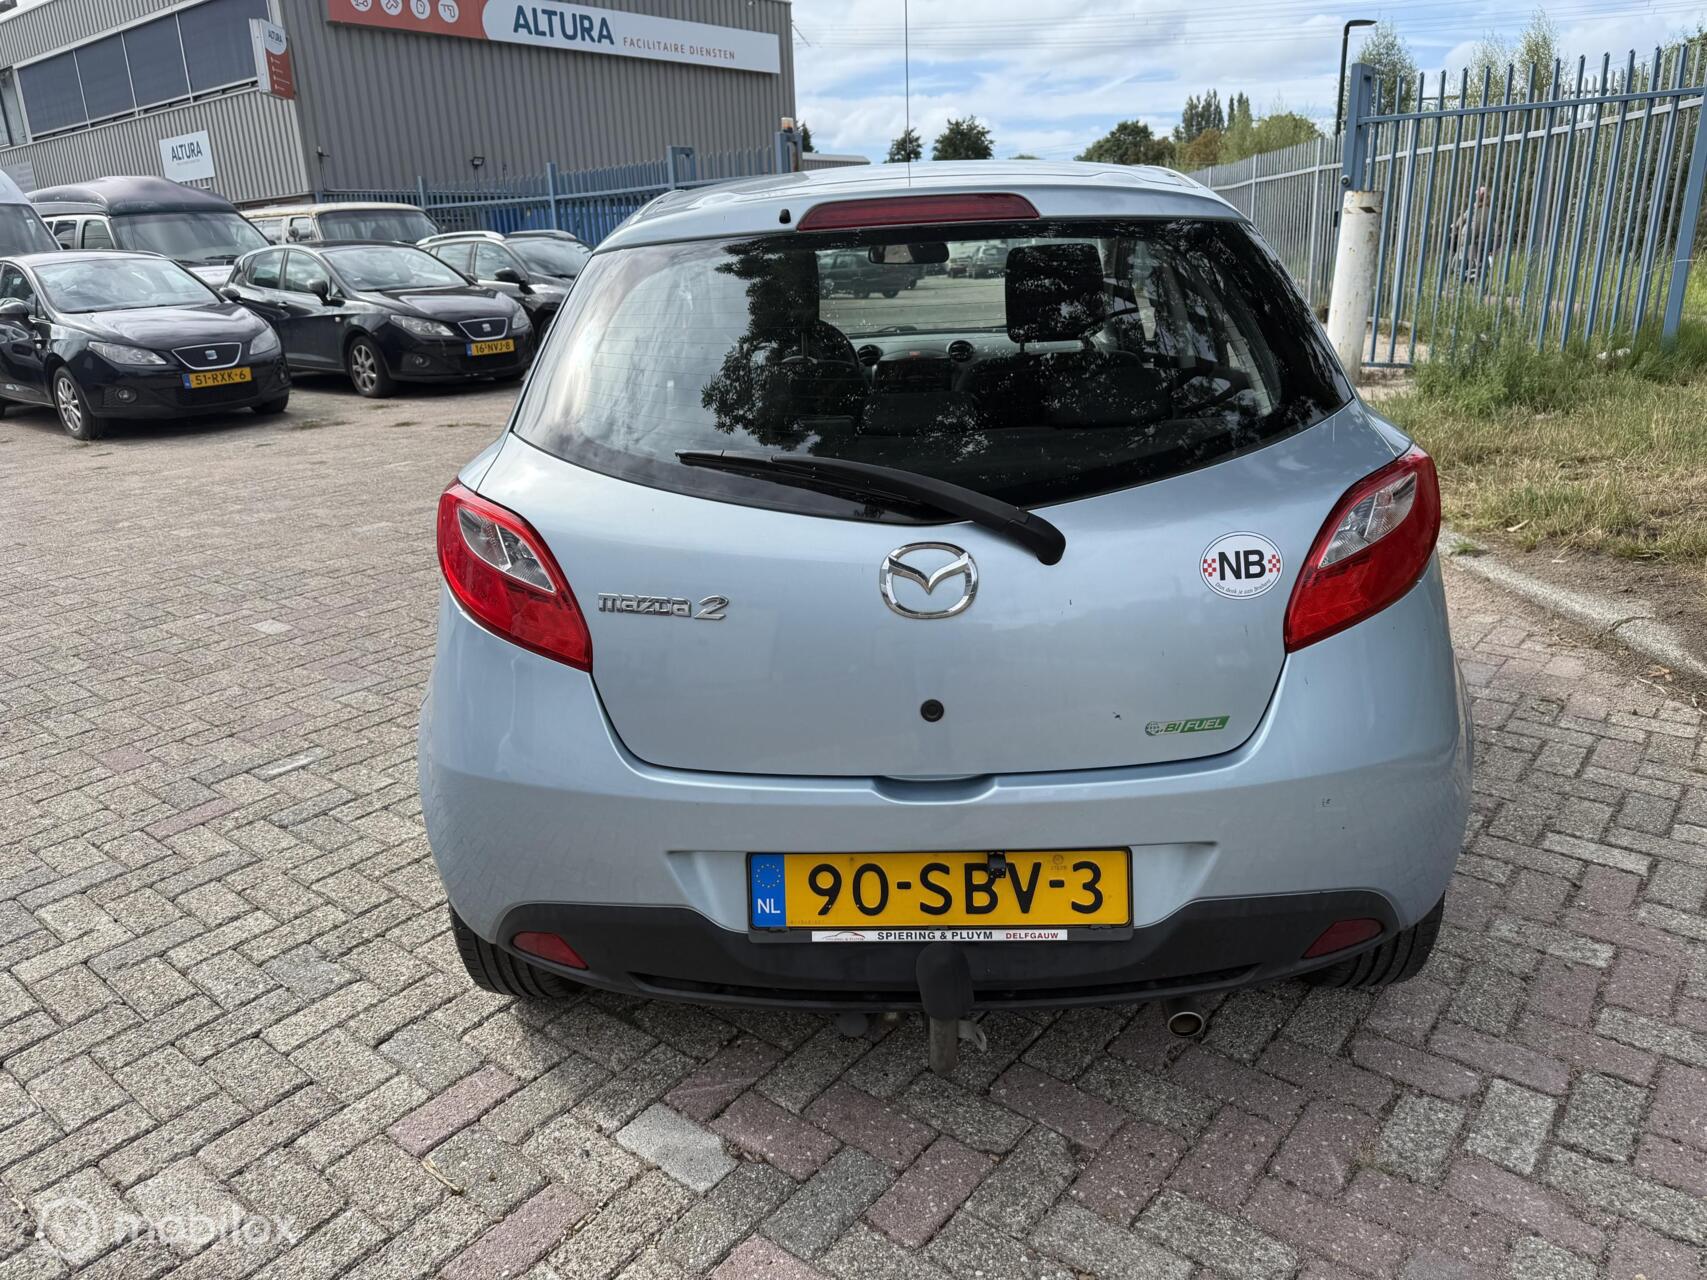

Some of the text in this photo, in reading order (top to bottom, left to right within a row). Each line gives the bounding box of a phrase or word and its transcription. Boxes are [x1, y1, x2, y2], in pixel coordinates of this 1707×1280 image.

[513, 5, 614, 45] ALTURA
[623, 36, 735, 60] FACILITAIRE DIENSTEN
[171, 140, 203, 162] ALTURA
[474, 341, 511, 354] 16-NVJ-8
[195, 370, 247, 385] 51-RXK-6
[1218, 549, 1266, 581] NB
[694, 594, 729, 620] 2
[1184, 719, 1223, 731] FUEL
[808, 862, 1104, 916] 90-SBV-3
[757, 898, 781, 914] NL
[877, 931, 1058, 940] SPIERING & PLUYM DELFGAUW
